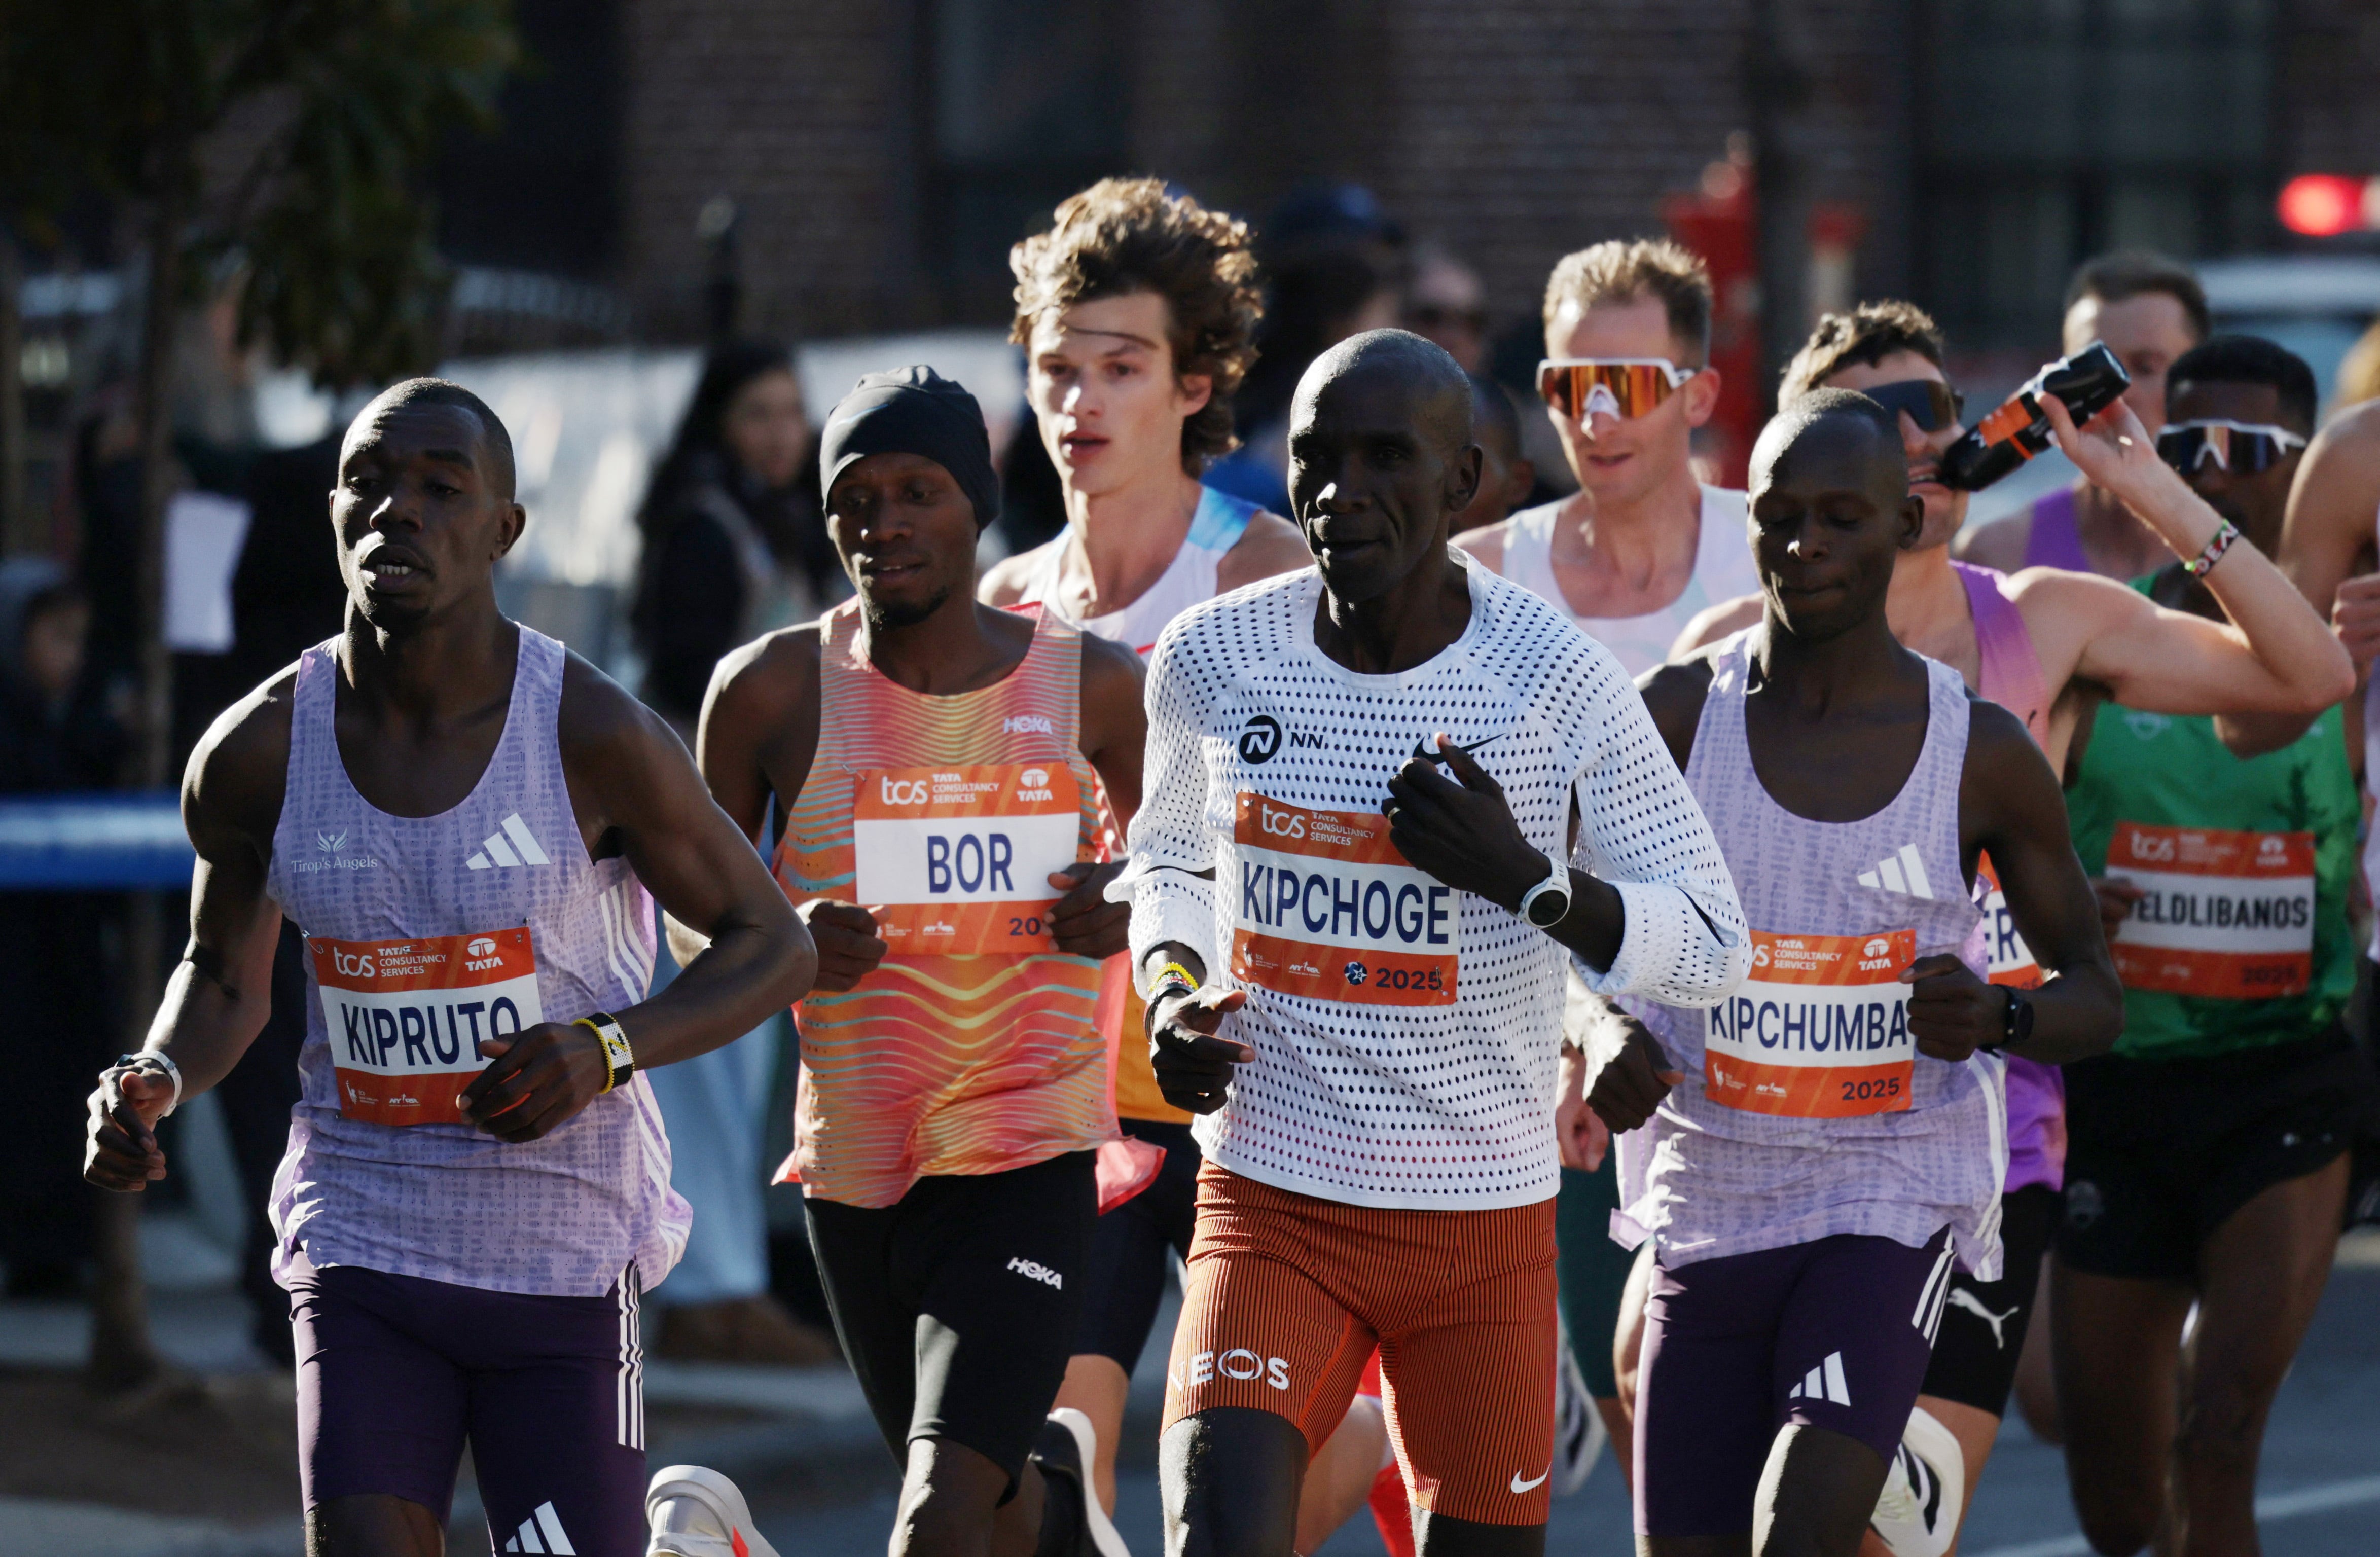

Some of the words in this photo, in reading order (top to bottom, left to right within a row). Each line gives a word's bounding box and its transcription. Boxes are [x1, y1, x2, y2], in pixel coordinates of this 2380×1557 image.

[1004, 716, 1053, 735] HOKA
[1290, 732, 1324, 749] NN
[932, 773, 961, 783] TATA
[882, 776, 928, 805] tcs
[932, 783, 999, 793] CONSULTANCY
[1017, 789, 1053, 802] TATA
[933, 794, 976, 804] SERVICES
[1262, 803, 1305, 839] tcs
[1312, 811, 1339, 823] TATA
[1310, 821, 1374, 839] CONSULTANCY
[1310, 832, 1352, 846] SERVICES
[291, 856, 331, 874] Tirop's
[333, 855, 378, 870] Angels
[927, 833, 1015, 893] BOR
[1243, 861, 1450, 945] KIPCHOGE
[2133, 890, 2308, 928] ELDLIBANOS
[1775, 940, 1804, 949] TATA
[333, 946, 375, 977] tcs
[379, 954, 447, 967] CONSULTANCY
[465, 957, 503, 971] TATA
[1775, 950, 1842, 961] CONSULTANCY
[381, 966, 424, 977] SERVICES
[1774, 960, 1817, 971] SERVICES
[1858, 958, 1892, 971] TATA
[1376, 968, 1443, 990] 2025
[341, 996, 521, 1067] KIPRUTO
[1711, 995, 1907, 1052] KIPCHUMBA
[1842, 1077, 1900, 1101] 2025
[1007, 1257, 1062, 1290] HOKA
